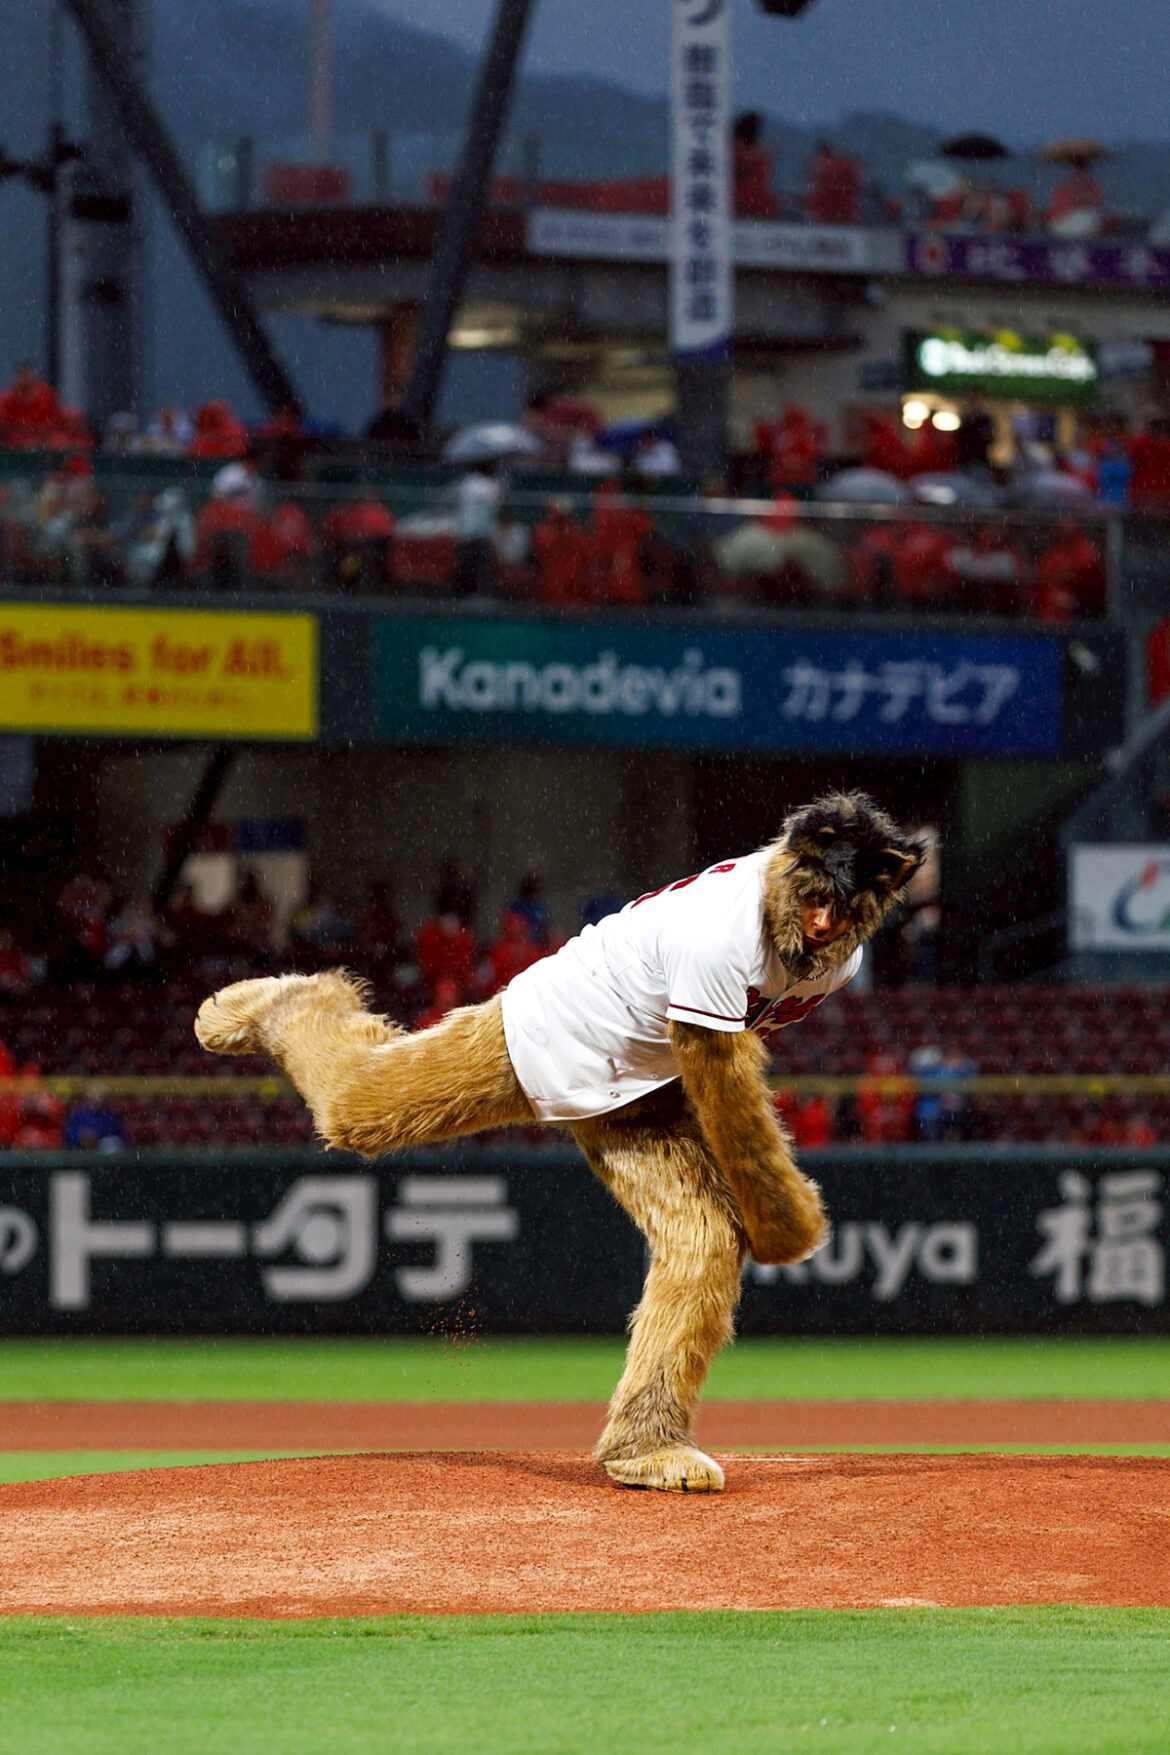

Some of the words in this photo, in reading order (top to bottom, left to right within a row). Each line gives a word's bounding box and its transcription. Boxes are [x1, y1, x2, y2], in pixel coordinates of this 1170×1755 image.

[151, 634, 211, 675] for
[418, 646, 743, 717] Kanadevia
[782, 659, 1020, 724] カナデビア
[1030, 1169, 1166, 1305] 福
